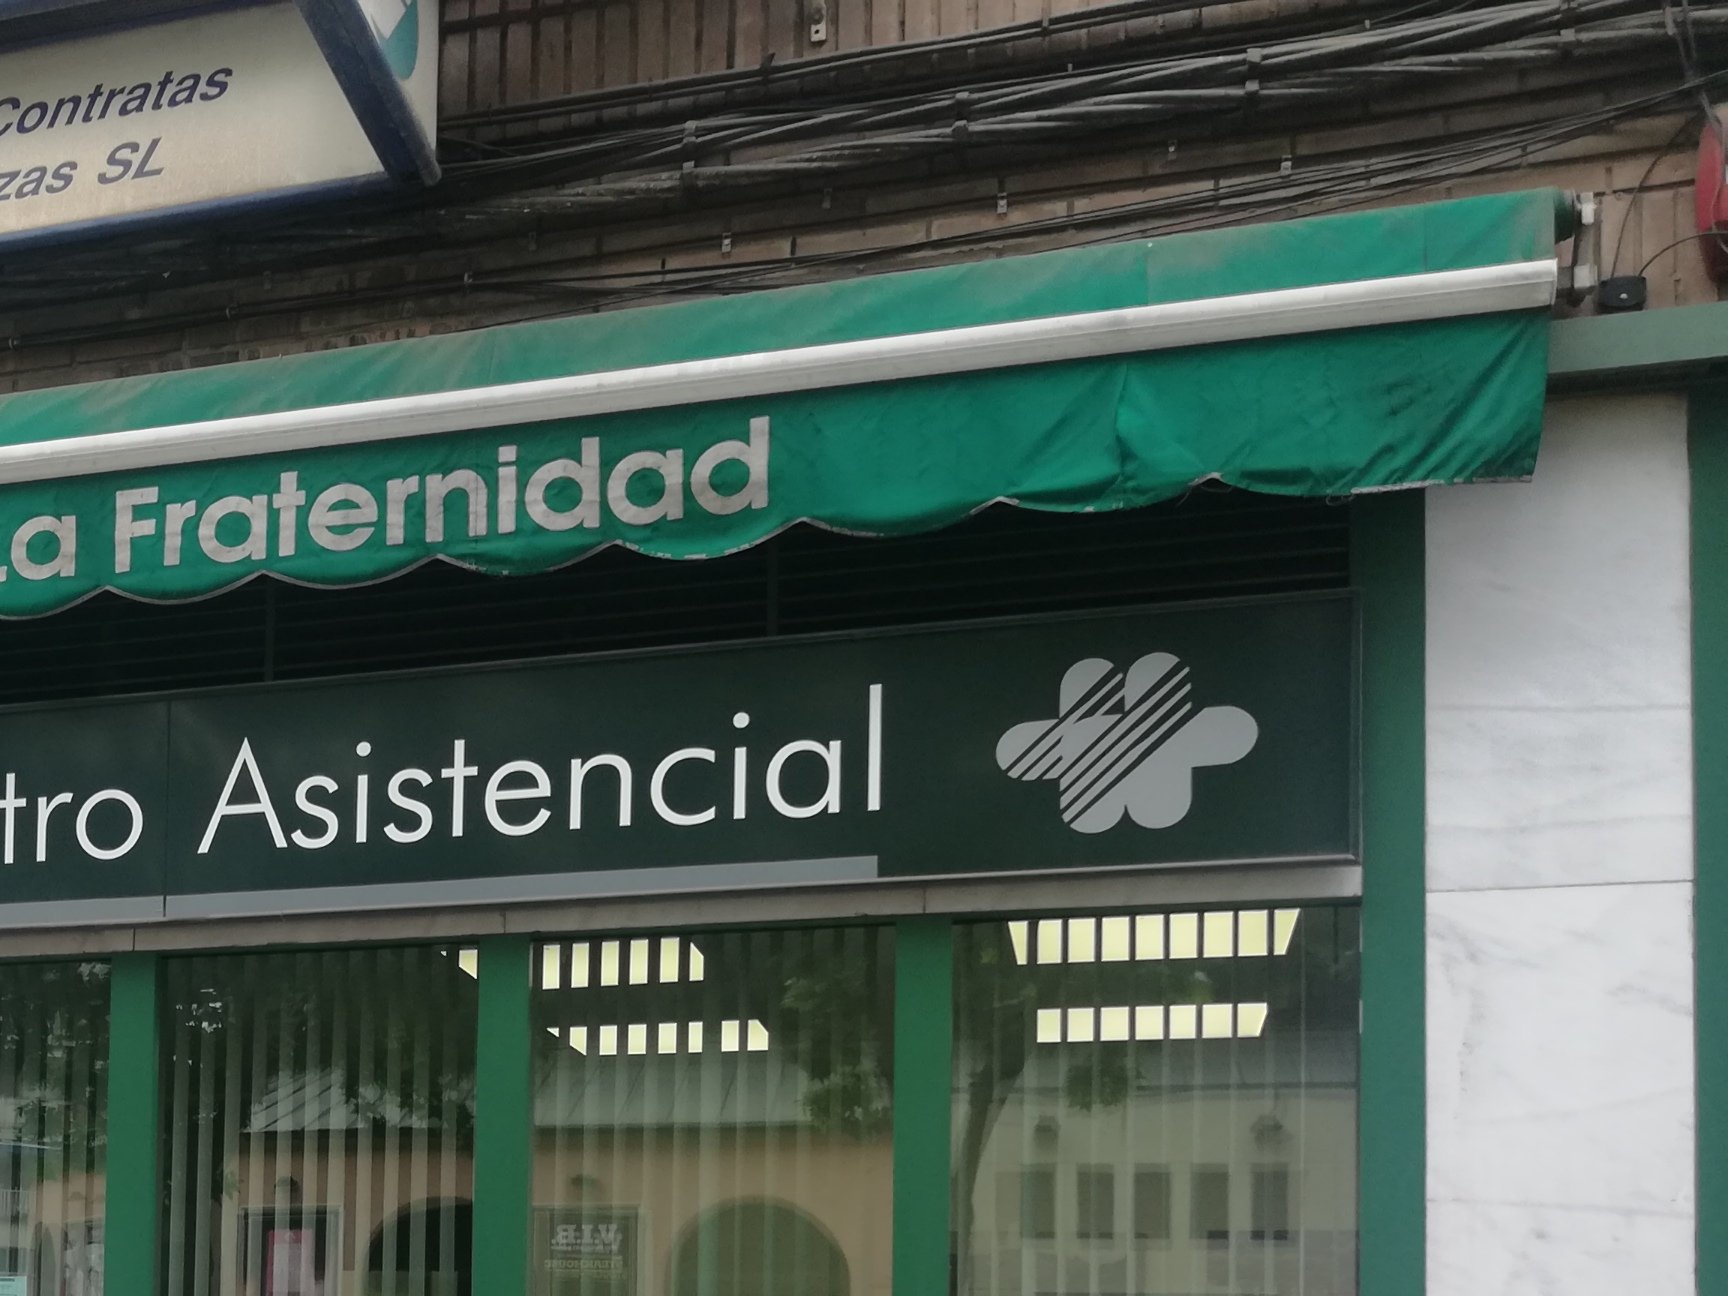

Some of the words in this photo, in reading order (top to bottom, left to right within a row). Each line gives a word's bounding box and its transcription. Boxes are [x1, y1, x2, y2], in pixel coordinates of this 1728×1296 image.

[97, 137, 166, 184] SL
[114, 415, 770, 574] Fraternidad
[197, 683, 883, 855] Asistencial
